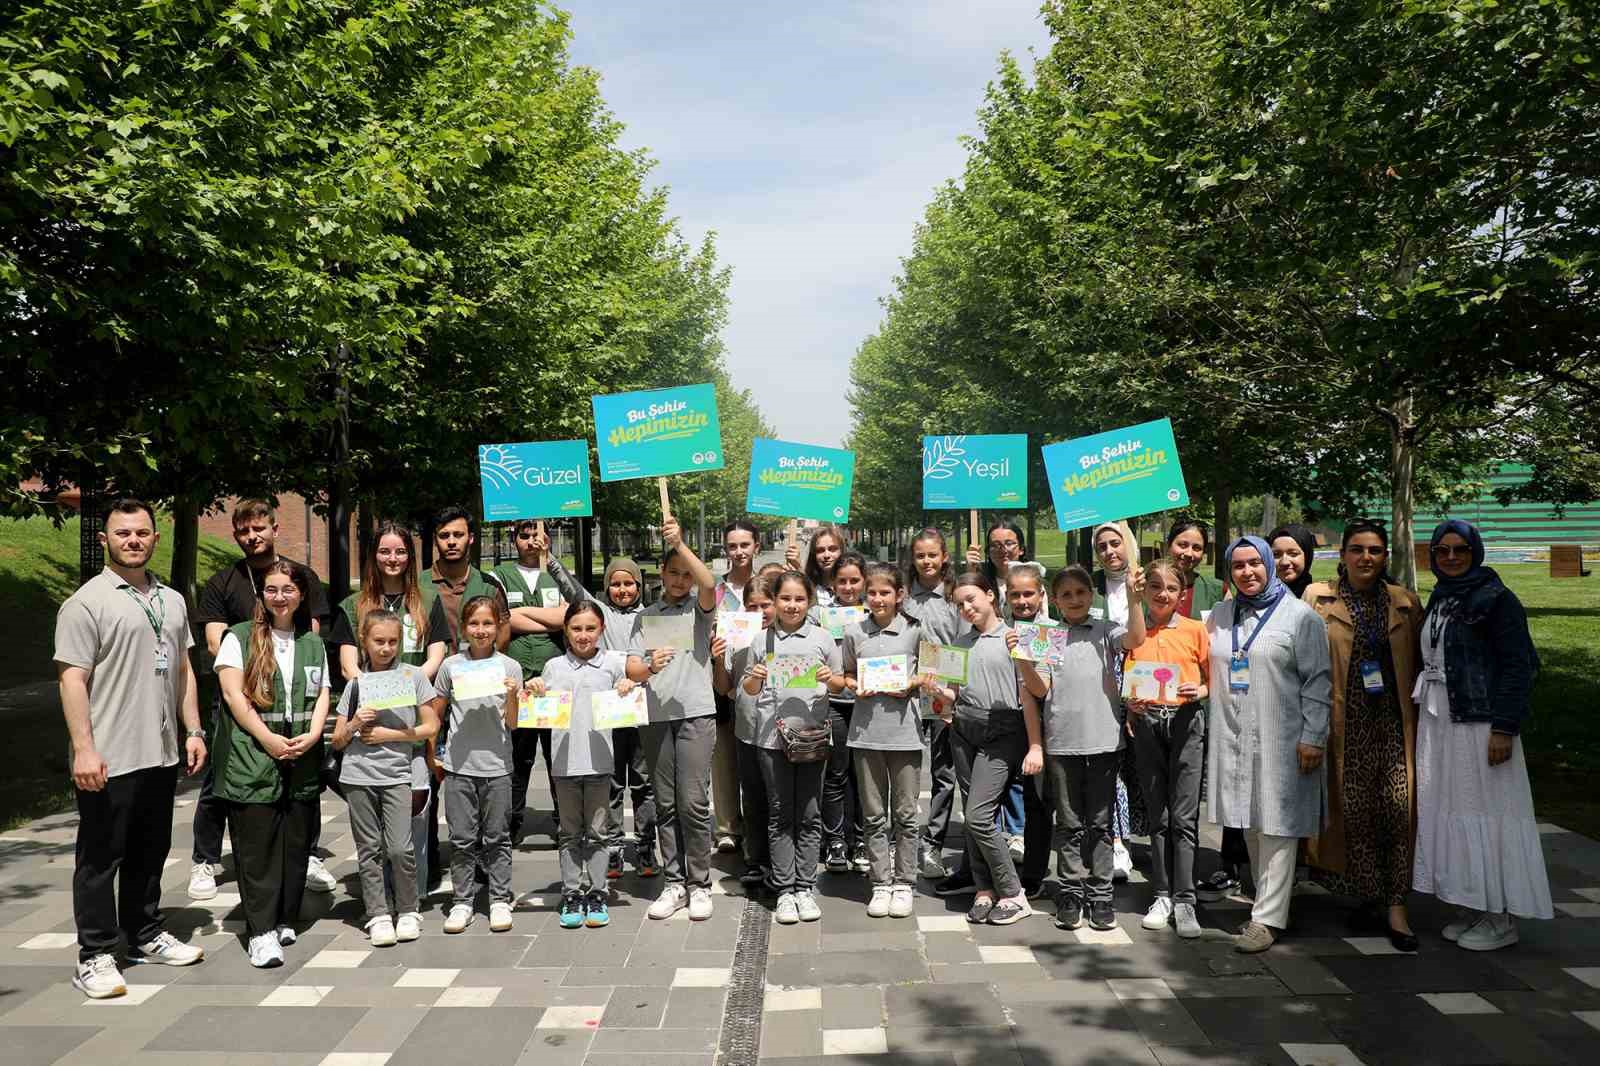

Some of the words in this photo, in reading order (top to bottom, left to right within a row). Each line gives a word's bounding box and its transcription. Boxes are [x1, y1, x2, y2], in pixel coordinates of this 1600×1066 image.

[627, 408, 647, 423] Bu
[648, 400, 688, 420] Şehir
[608, 409, 709, 447] Hepimizin
[777, 456, 795, 468] Bu
[1080, 454, 1101, 469] Bu
[1101, 439, 1142, 463] Şehir
[523, 464, 581, 487] Güzel
[758, 467, 844, 486] Hepimizin
[962, 457, 1009, 480] Yeşil
[1062, 447, 1168, 496] Hepimizin
